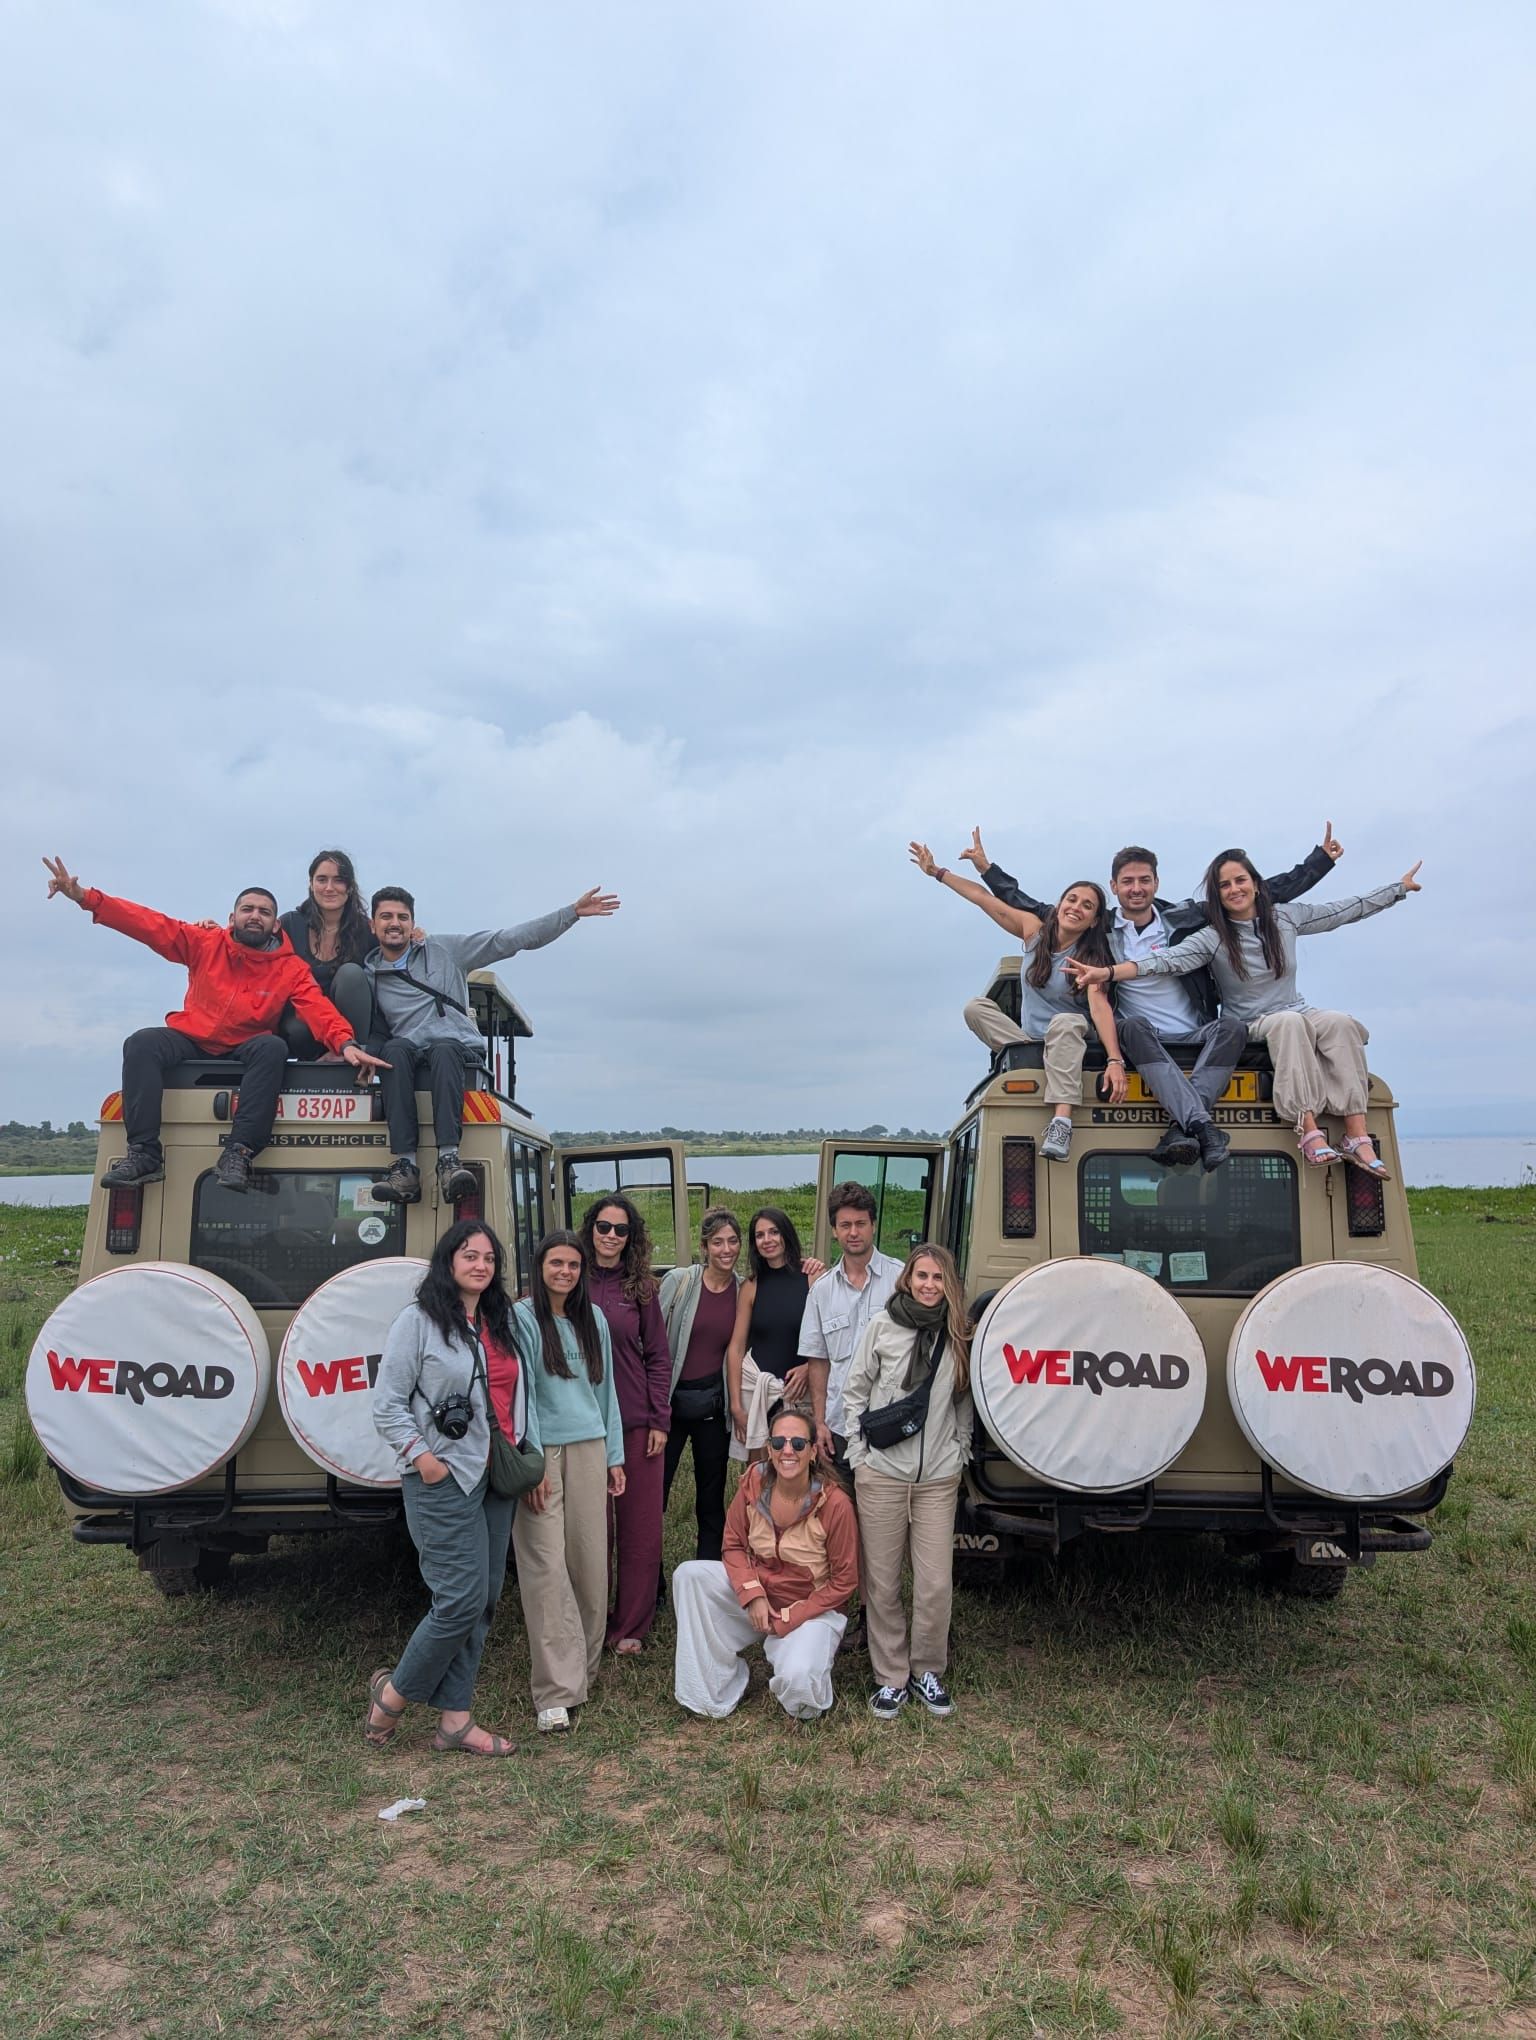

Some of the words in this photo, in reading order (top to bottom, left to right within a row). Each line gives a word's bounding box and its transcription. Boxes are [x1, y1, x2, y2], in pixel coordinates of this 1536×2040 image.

[297, 1098, 356, 1119] 839AP
[1101, 1109, 1171, 1123] TOURIS
[308, 1135, 382, 1146] VEHICLE
[47, 1350, 235, 1406] WEROAD
[1003, 1343, 1190, 1396] WEROAD
[1255, 1350, 1455, 1404] WEROAD
